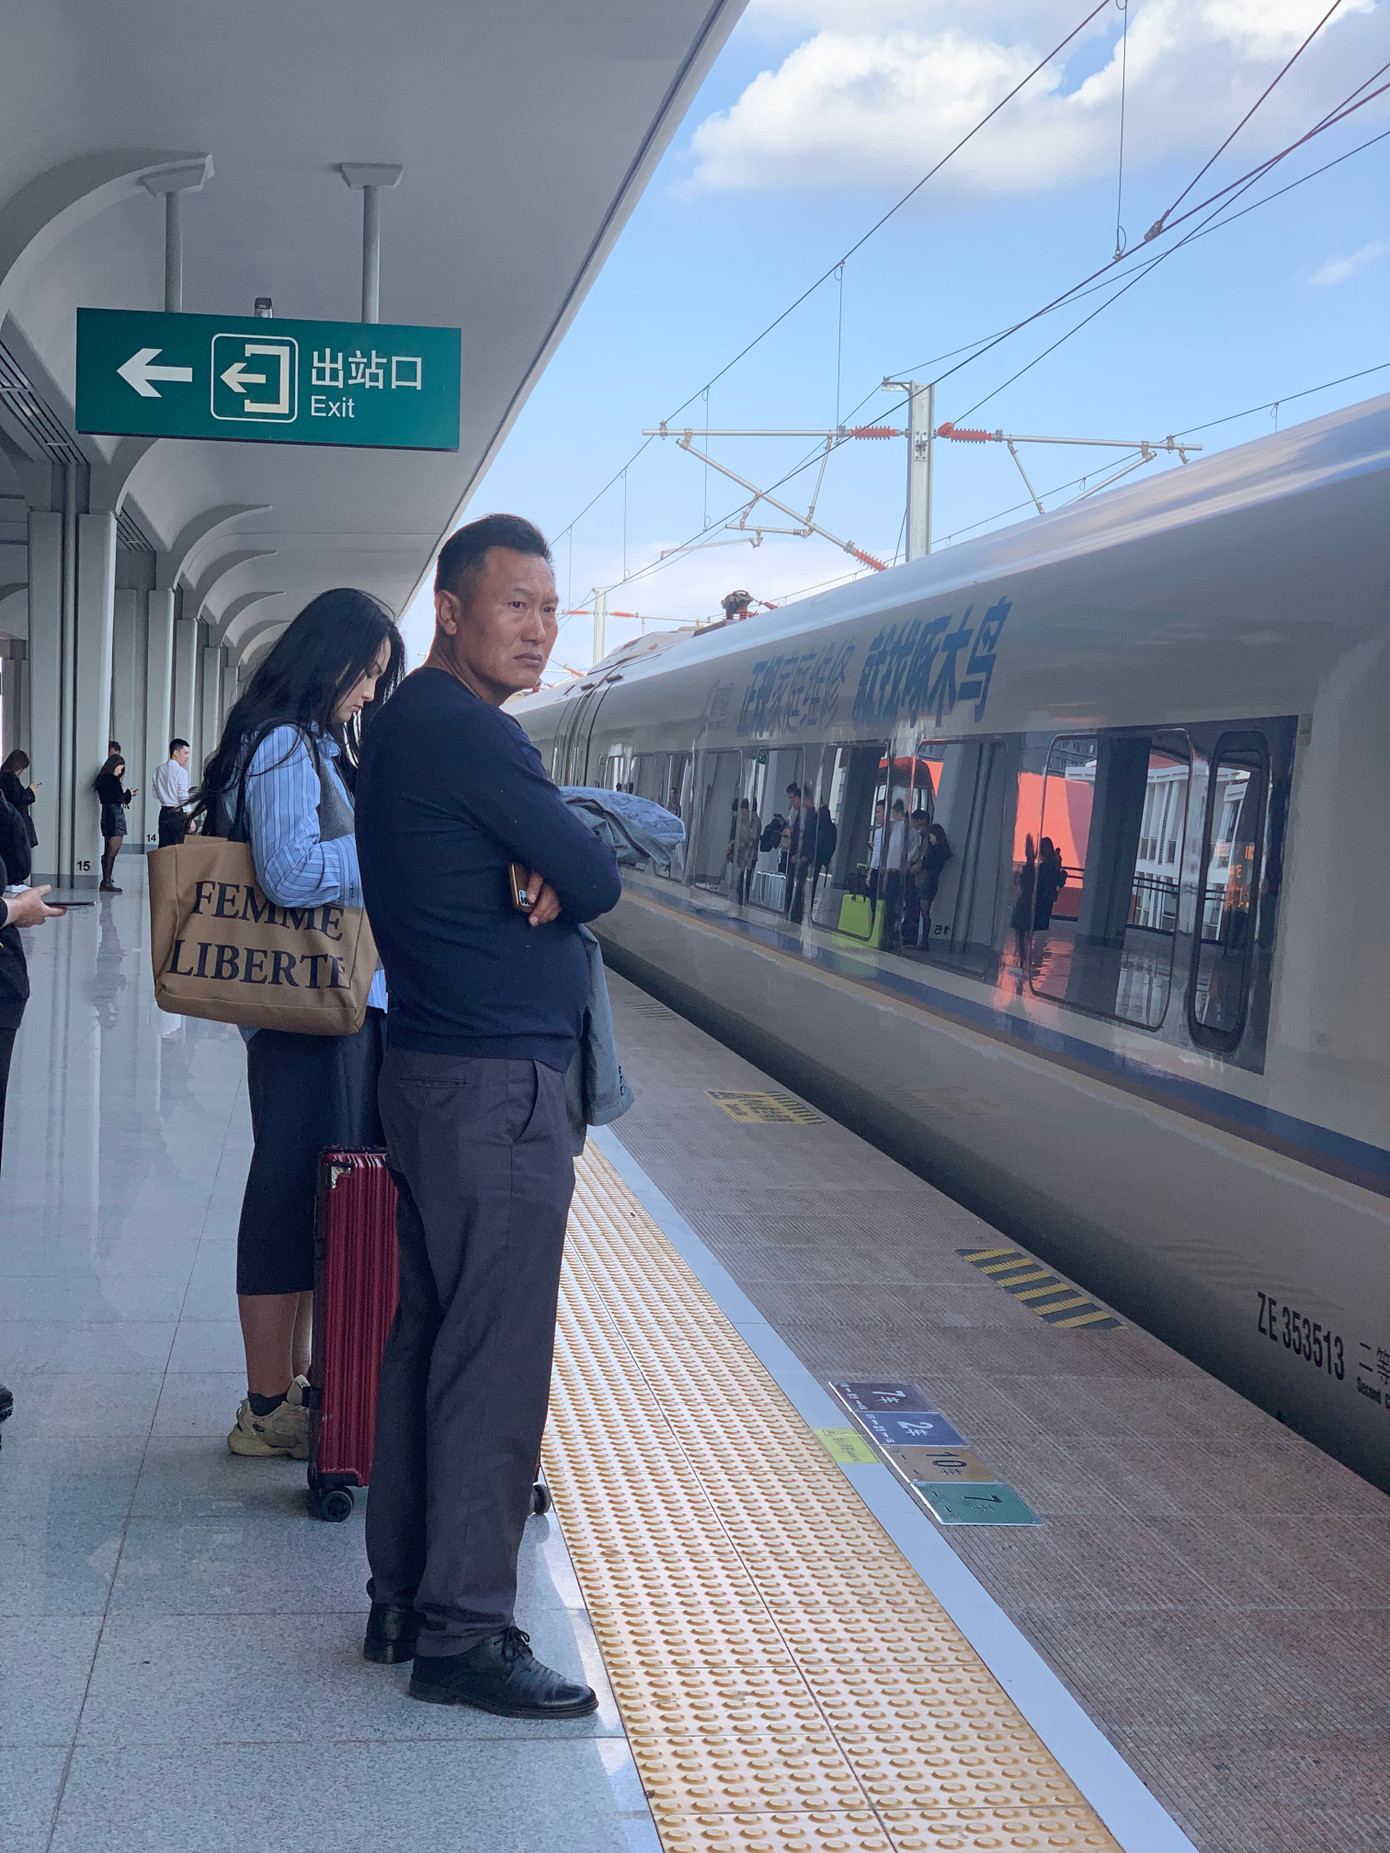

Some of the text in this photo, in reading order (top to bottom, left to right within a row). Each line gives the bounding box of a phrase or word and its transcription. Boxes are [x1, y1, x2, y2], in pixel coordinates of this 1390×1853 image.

[311, 348, 422, 390] 出站口
[311, 396, 355, 418] Exit
[146, 834, 157, 842] 14
[76, 860, 91, 872] 15
[191, 880, 345, 942] FEMME
[1257, 1291, 1345, 1381] ZE 353513
[897, 1421, 934, 1437] 2车
[925, 1452, 968, 1476] 10车
